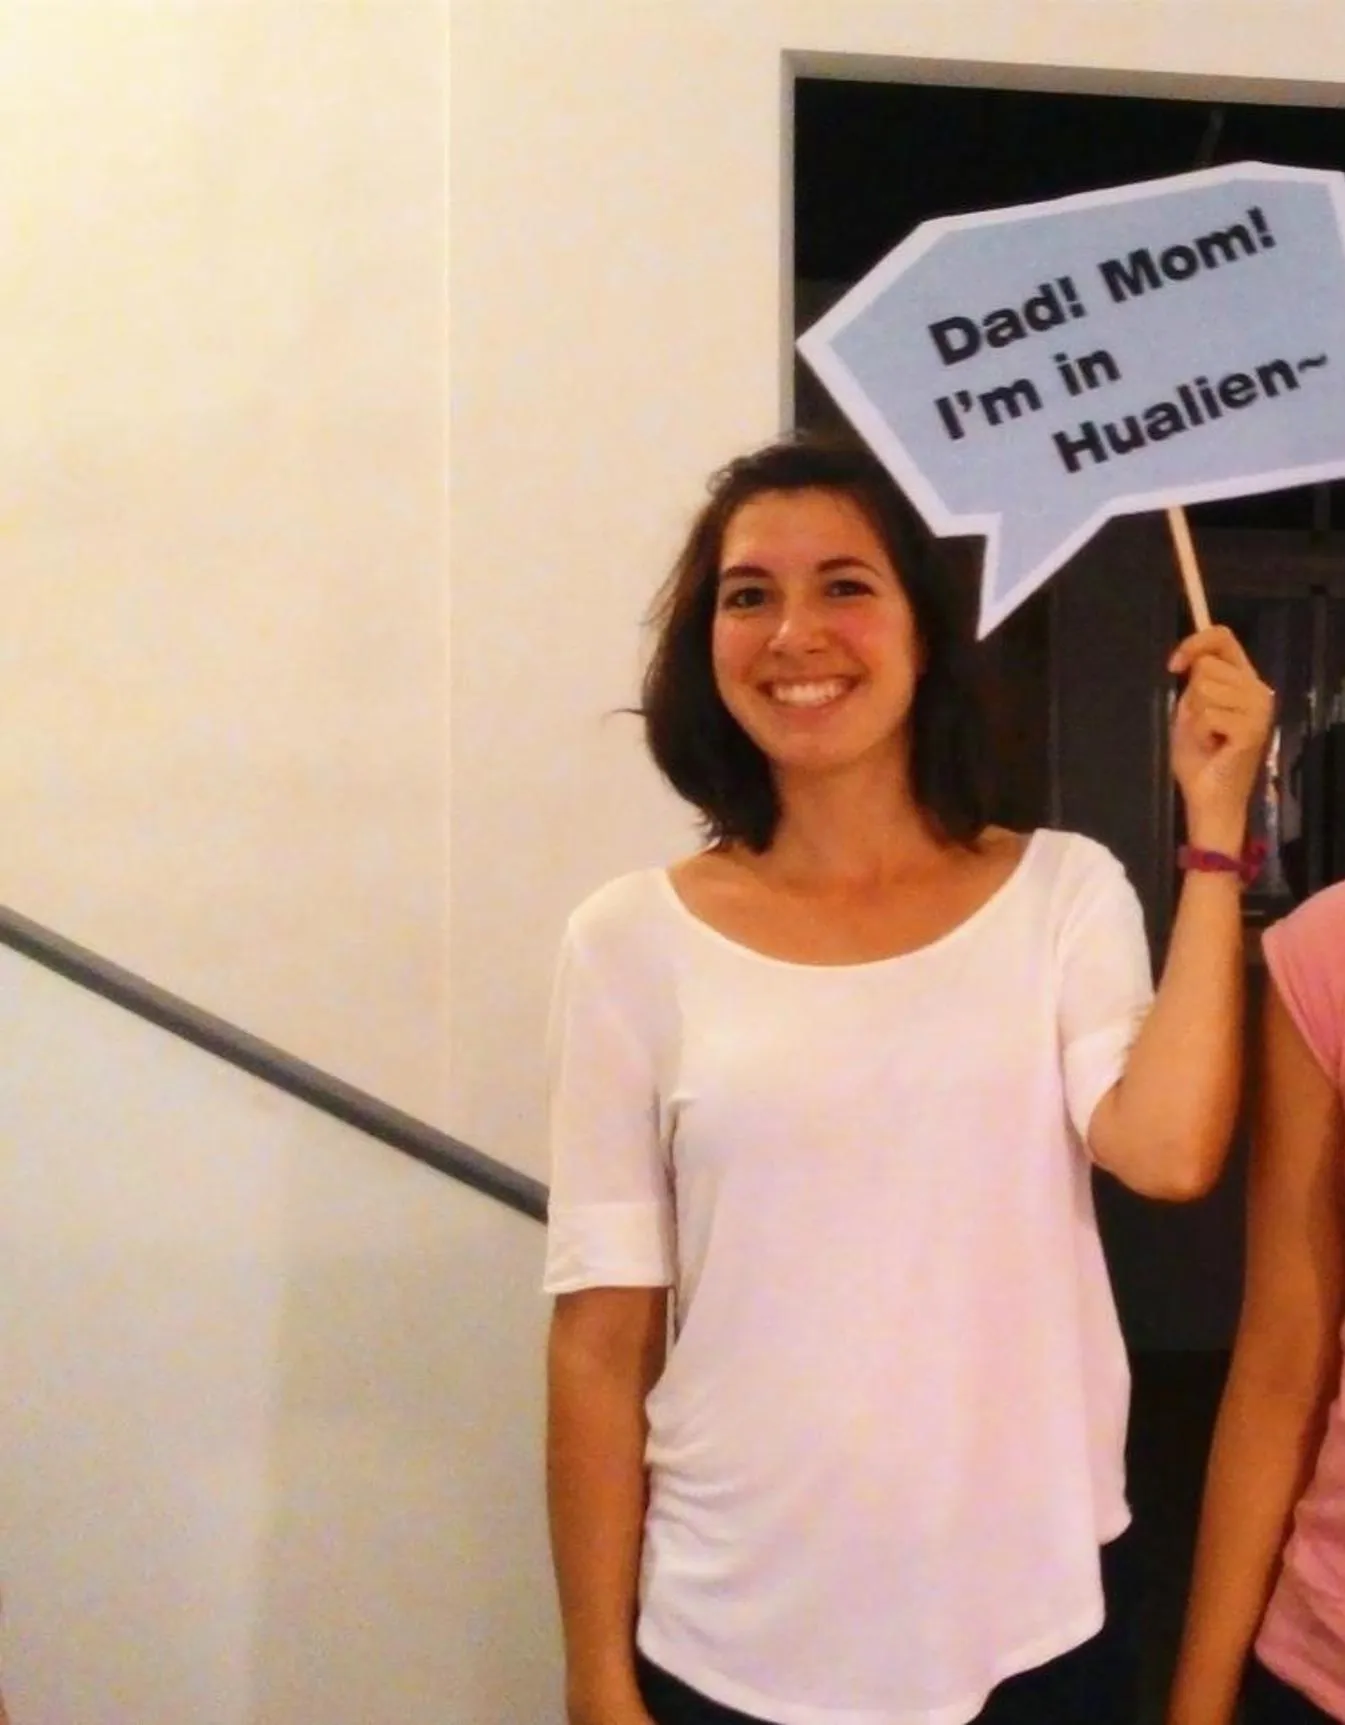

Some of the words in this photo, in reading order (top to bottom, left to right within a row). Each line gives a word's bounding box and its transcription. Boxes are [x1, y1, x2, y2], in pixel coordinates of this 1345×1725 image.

[926, 275, 1086, 366] Dad!
[1097, 206, 1276, 304] Mom!
[934, 378, 1043, 441] I'm
[1053, 349, 1121, 398] in
[1052, 354, 1328, 474] Hualien~
